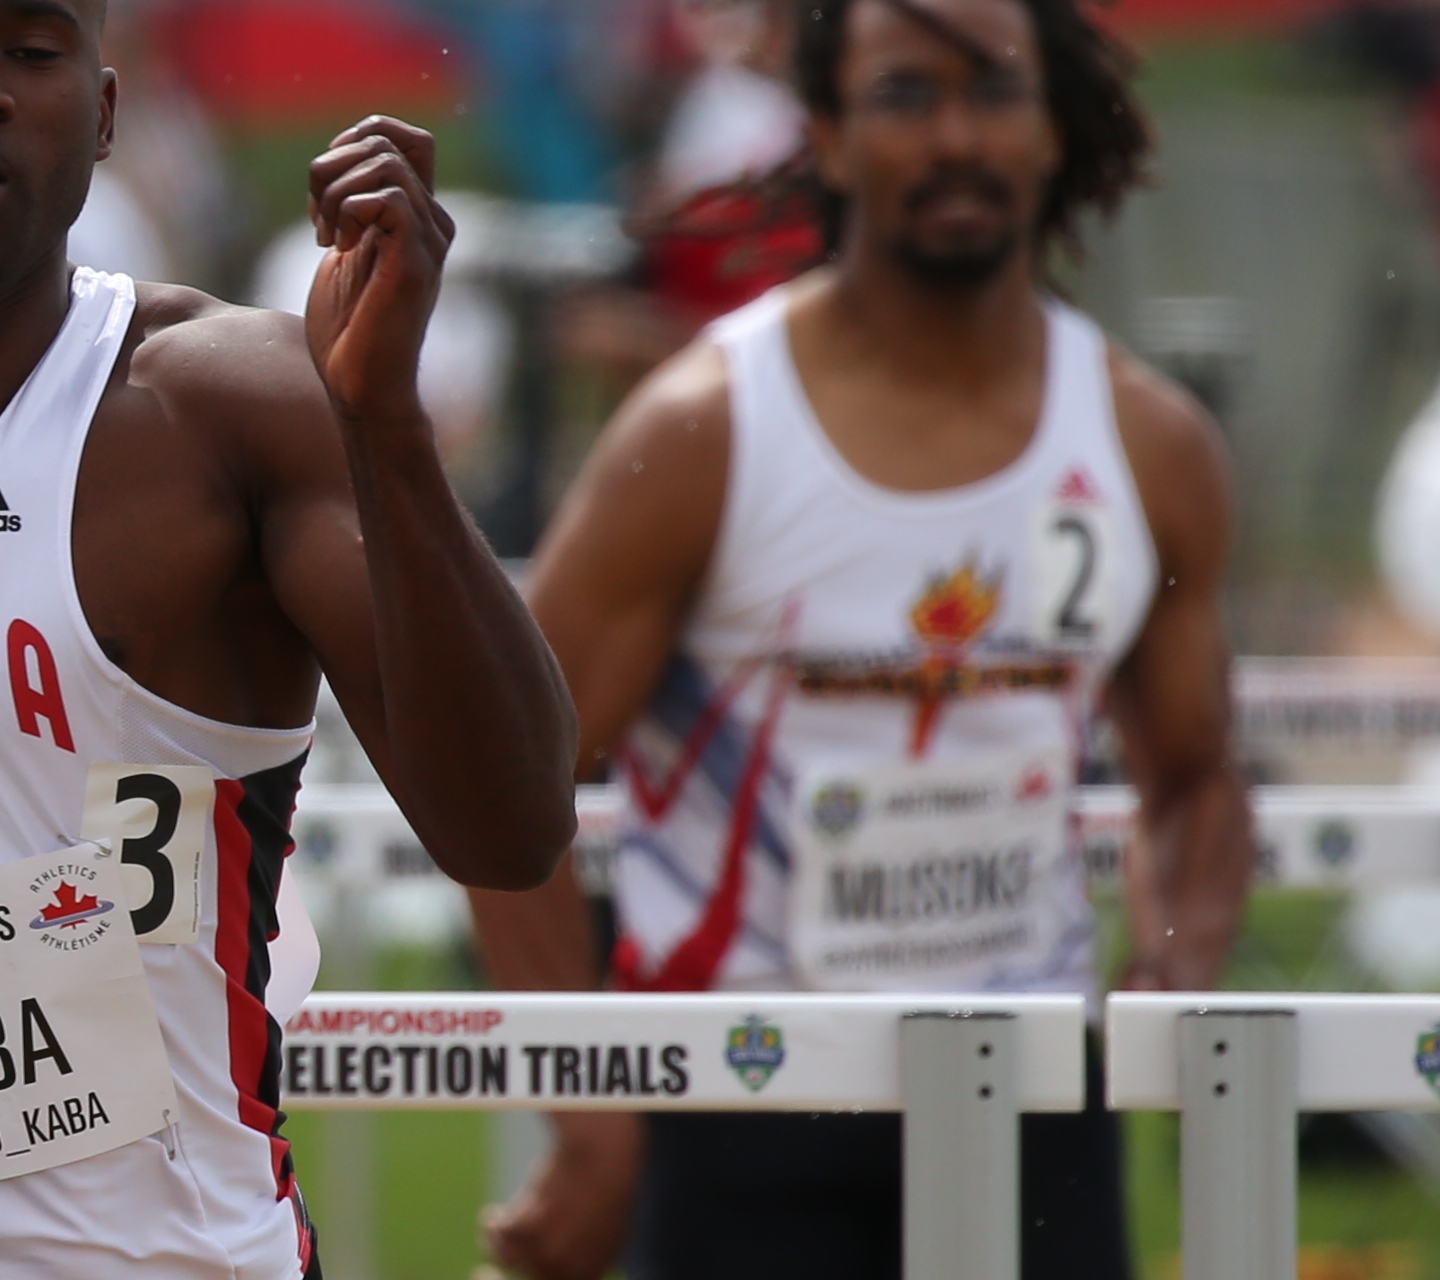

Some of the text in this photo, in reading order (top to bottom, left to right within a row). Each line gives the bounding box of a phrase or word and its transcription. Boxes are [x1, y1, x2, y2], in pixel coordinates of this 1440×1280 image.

[1052, 515, 1095, 638] 2
[115, 773, 182, 936] 3
[29, 864, 98, 893] ATHLETICS
[39, 919, 112, 951] ATHLÉTISME
[285, 1009, 503, 1035] AMPIONSHIP
[286, 1045, 689, 1097] ELECTION TRIALS
